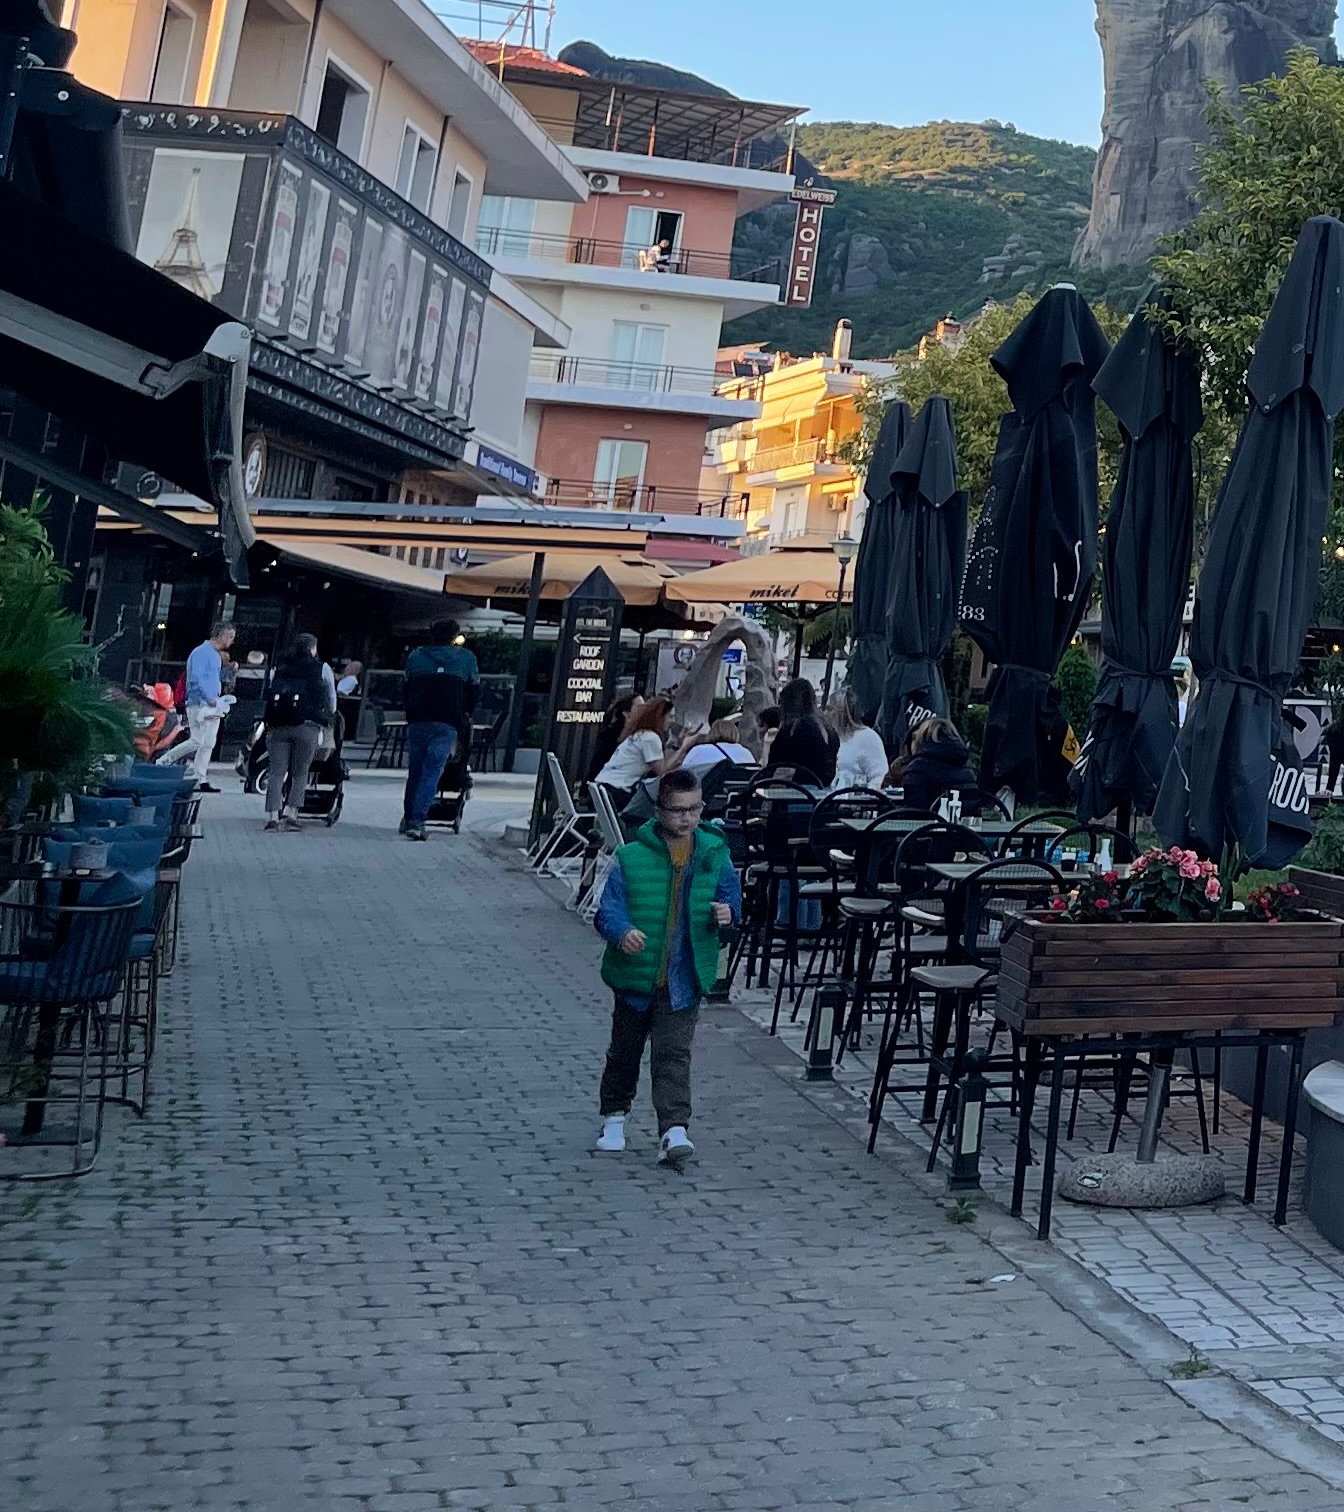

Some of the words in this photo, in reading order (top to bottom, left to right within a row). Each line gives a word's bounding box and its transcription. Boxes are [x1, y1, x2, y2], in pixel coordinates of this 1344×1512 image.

[791, 189, 835, 203] EDELWEISS
[792, 208, 818, 301] HOTEL
[494, 582, 547, 595] mikl
[749, 584, 800, 598] mikel
[580, 645, 601, 657] ROOF
[573, 659, 604, 670] GARDEN
[567, 677, 603, 689] COCKTAIL
[575, 691, 592, 703] BAR
[556, 710, 605, 723] RESTAURANT
